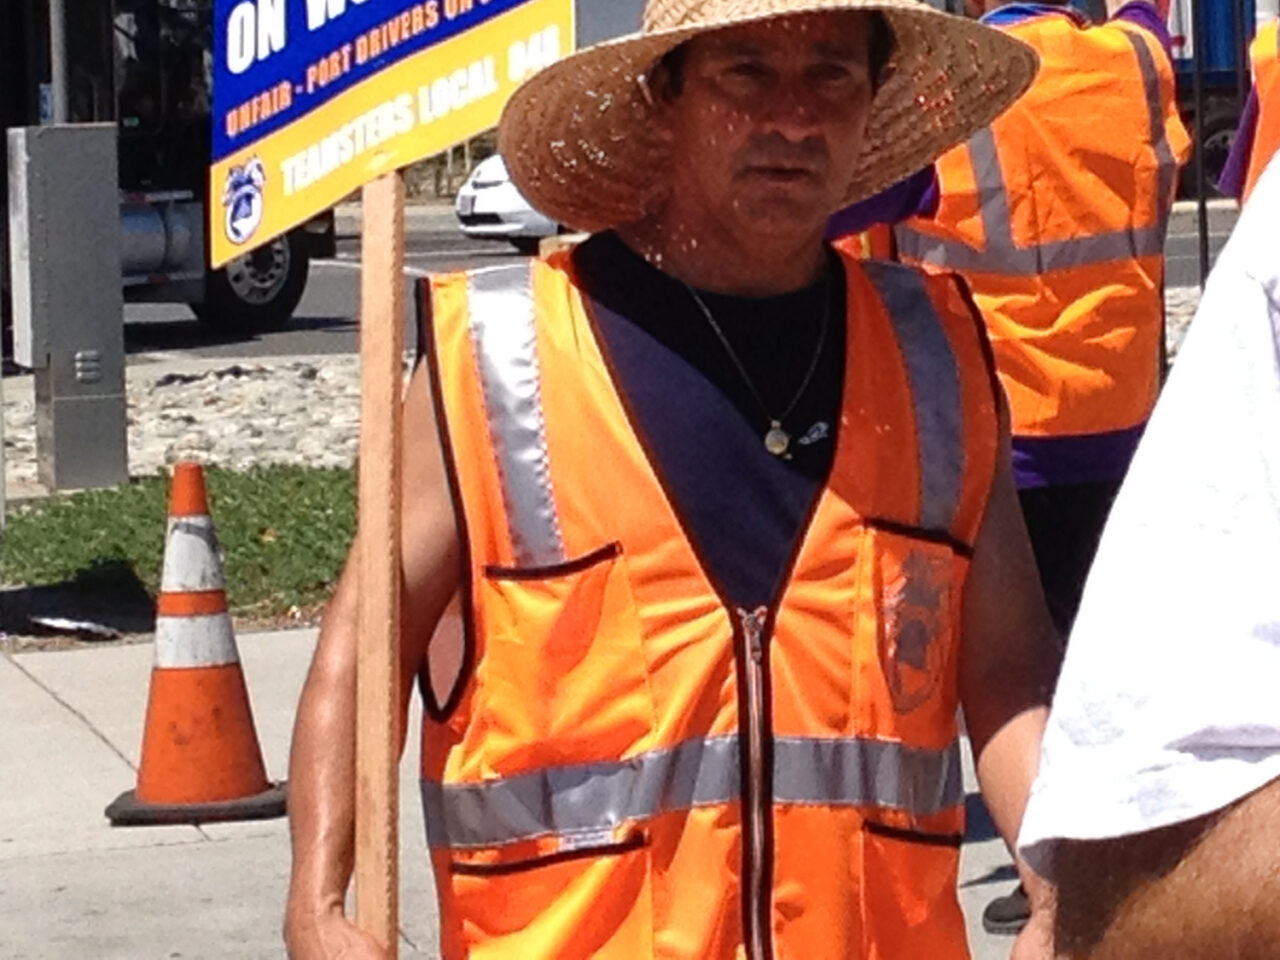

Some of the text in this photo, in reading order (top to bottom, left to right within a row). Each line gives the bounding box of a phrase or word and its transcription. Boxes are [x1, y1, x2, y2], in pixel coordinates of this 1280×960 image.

[225, 79, 292, 137] UNFAIR
[306, 45, 352, 93] PORT
[355, 0, 438, 65] DRIVERS
[280, 92, 415, 197] TEAMSTERS
[418, 55, 499, 127] LOCAL
